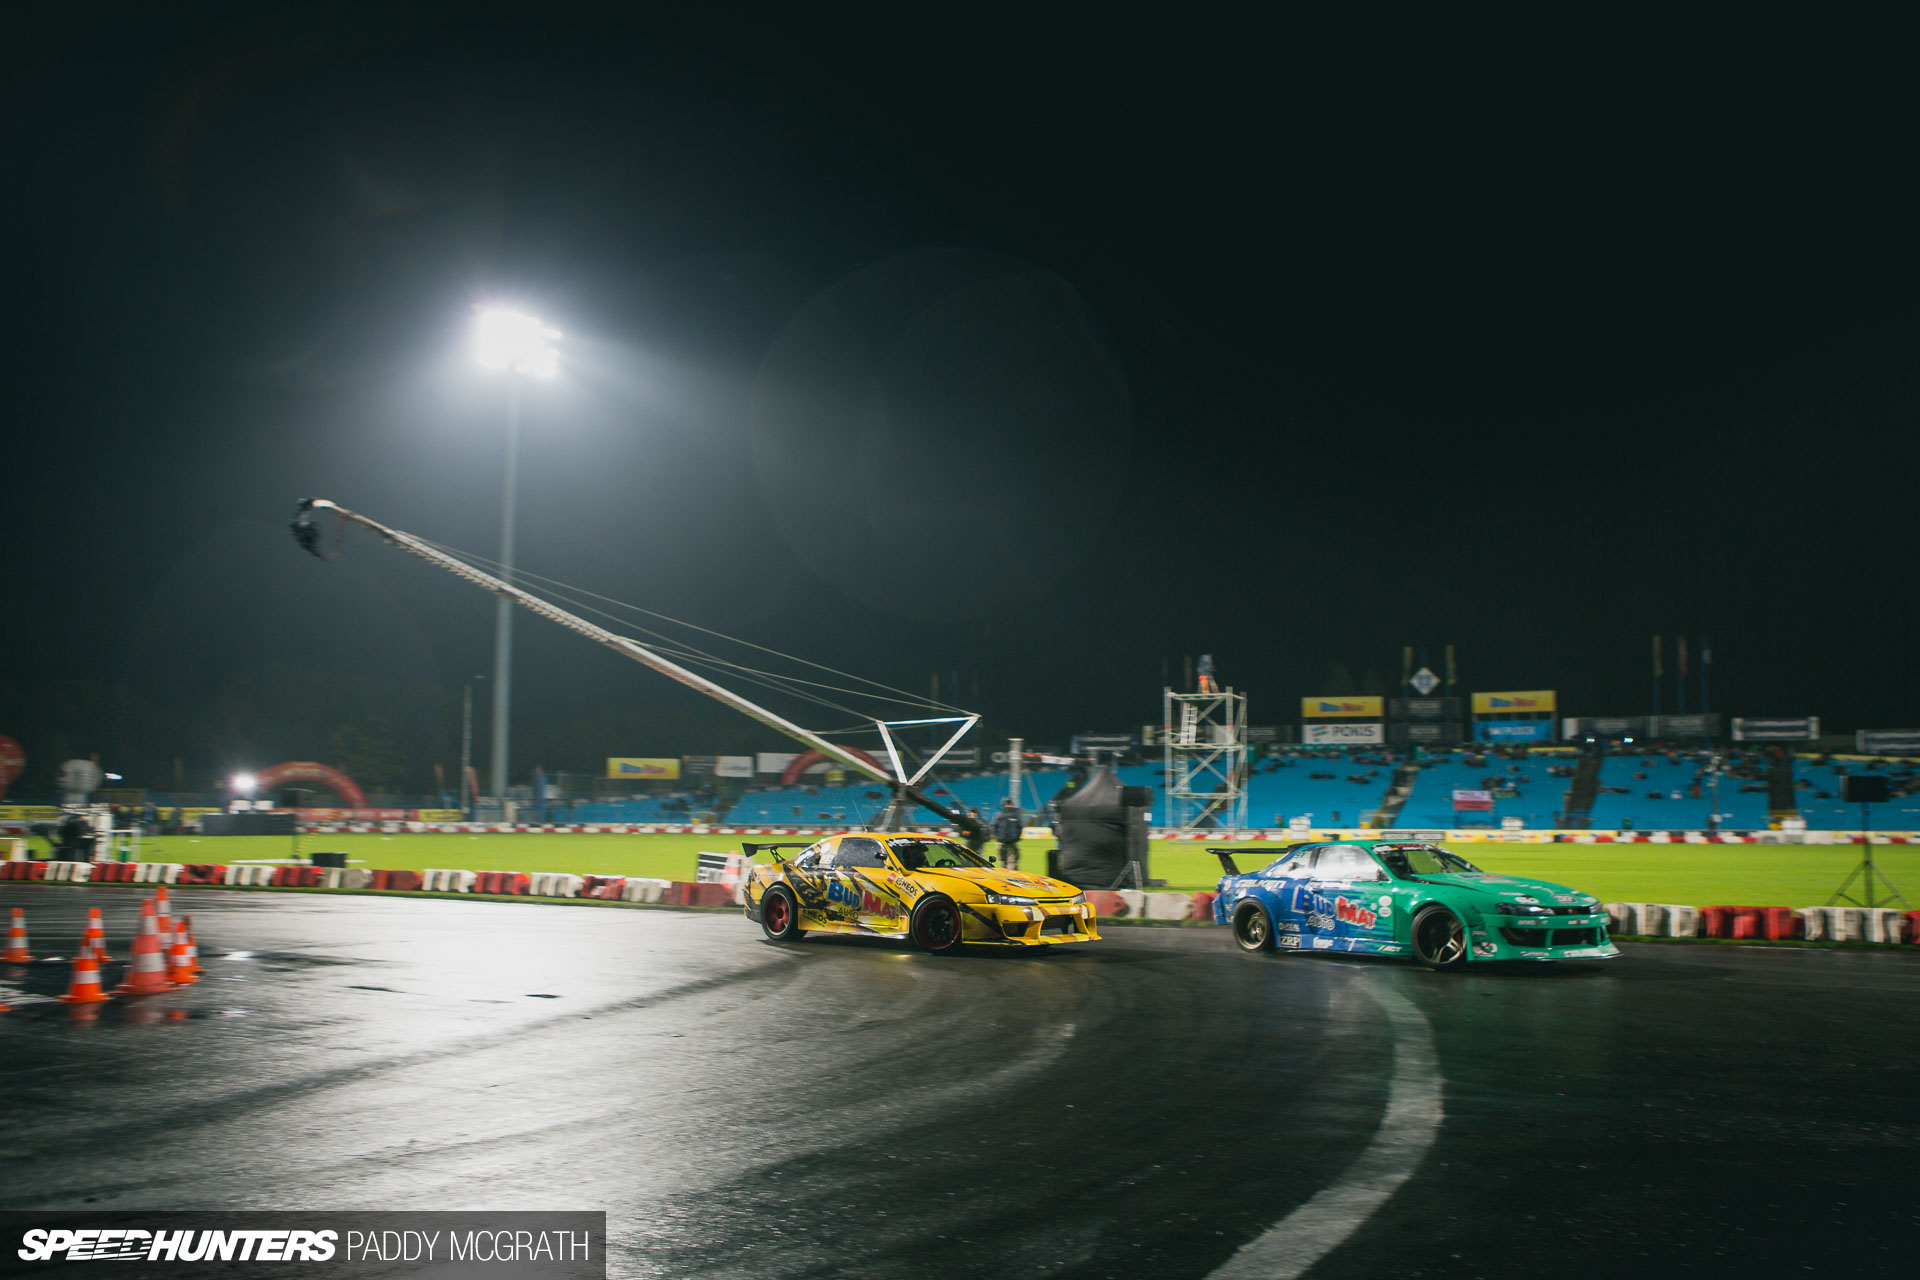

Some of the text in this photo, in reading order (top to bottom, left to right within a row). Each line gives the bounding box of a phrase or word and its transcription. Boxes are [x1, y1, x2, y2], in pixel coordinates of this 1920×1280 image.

[895, 876, 919, 897] ENEOS
[1234, 879, 1287, 889] FALKEN
[838, 906, 859, 920] AUTO
[1306, 915, 1336, 931] AUTO
